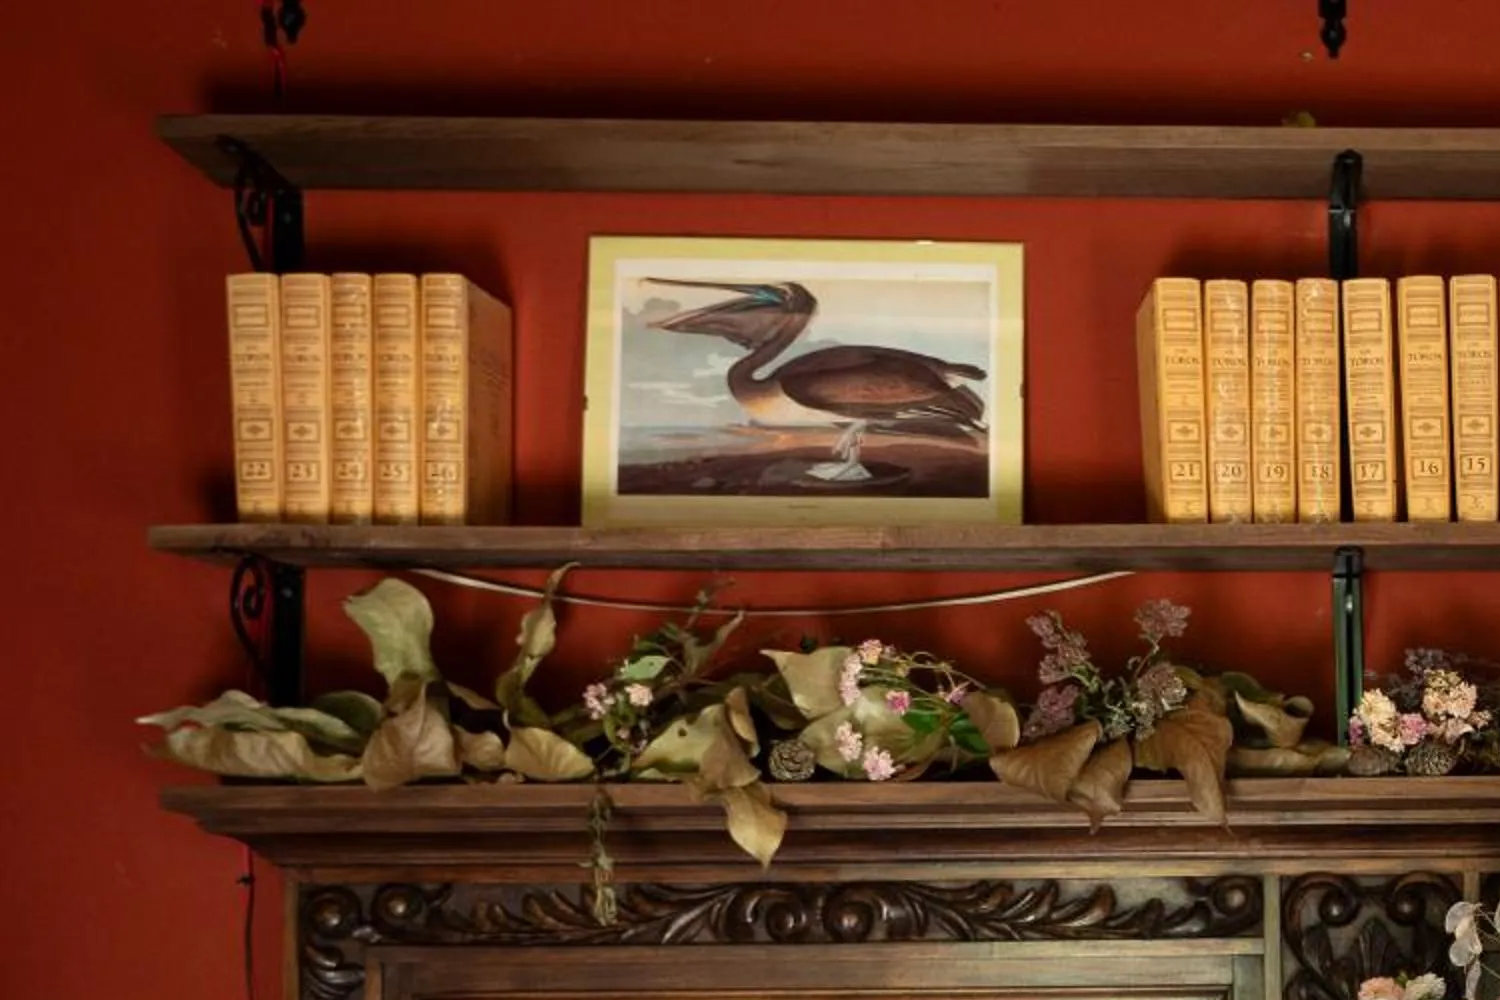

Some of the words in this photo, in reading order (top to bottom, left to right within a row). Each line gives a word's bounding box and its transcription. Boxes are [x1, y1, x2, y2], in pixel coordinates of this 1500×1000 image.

[246, 462, 267, 477] 22
[292, 464, 313, 478] 23
[383, 464, 403, 478] 25
[430, 463, 455, 478] 26
[1175, 463, 1195, 477] 21
[1221, 464, 1242, 478] 20
[1265, 464, 1284, 478] 19
[1359, 463, 1379, 478] 17
[1419, 460, 1439, 474] 16
[1468, 457, 1486, 471] 15
[1311, 465, 1329, 478] 18
